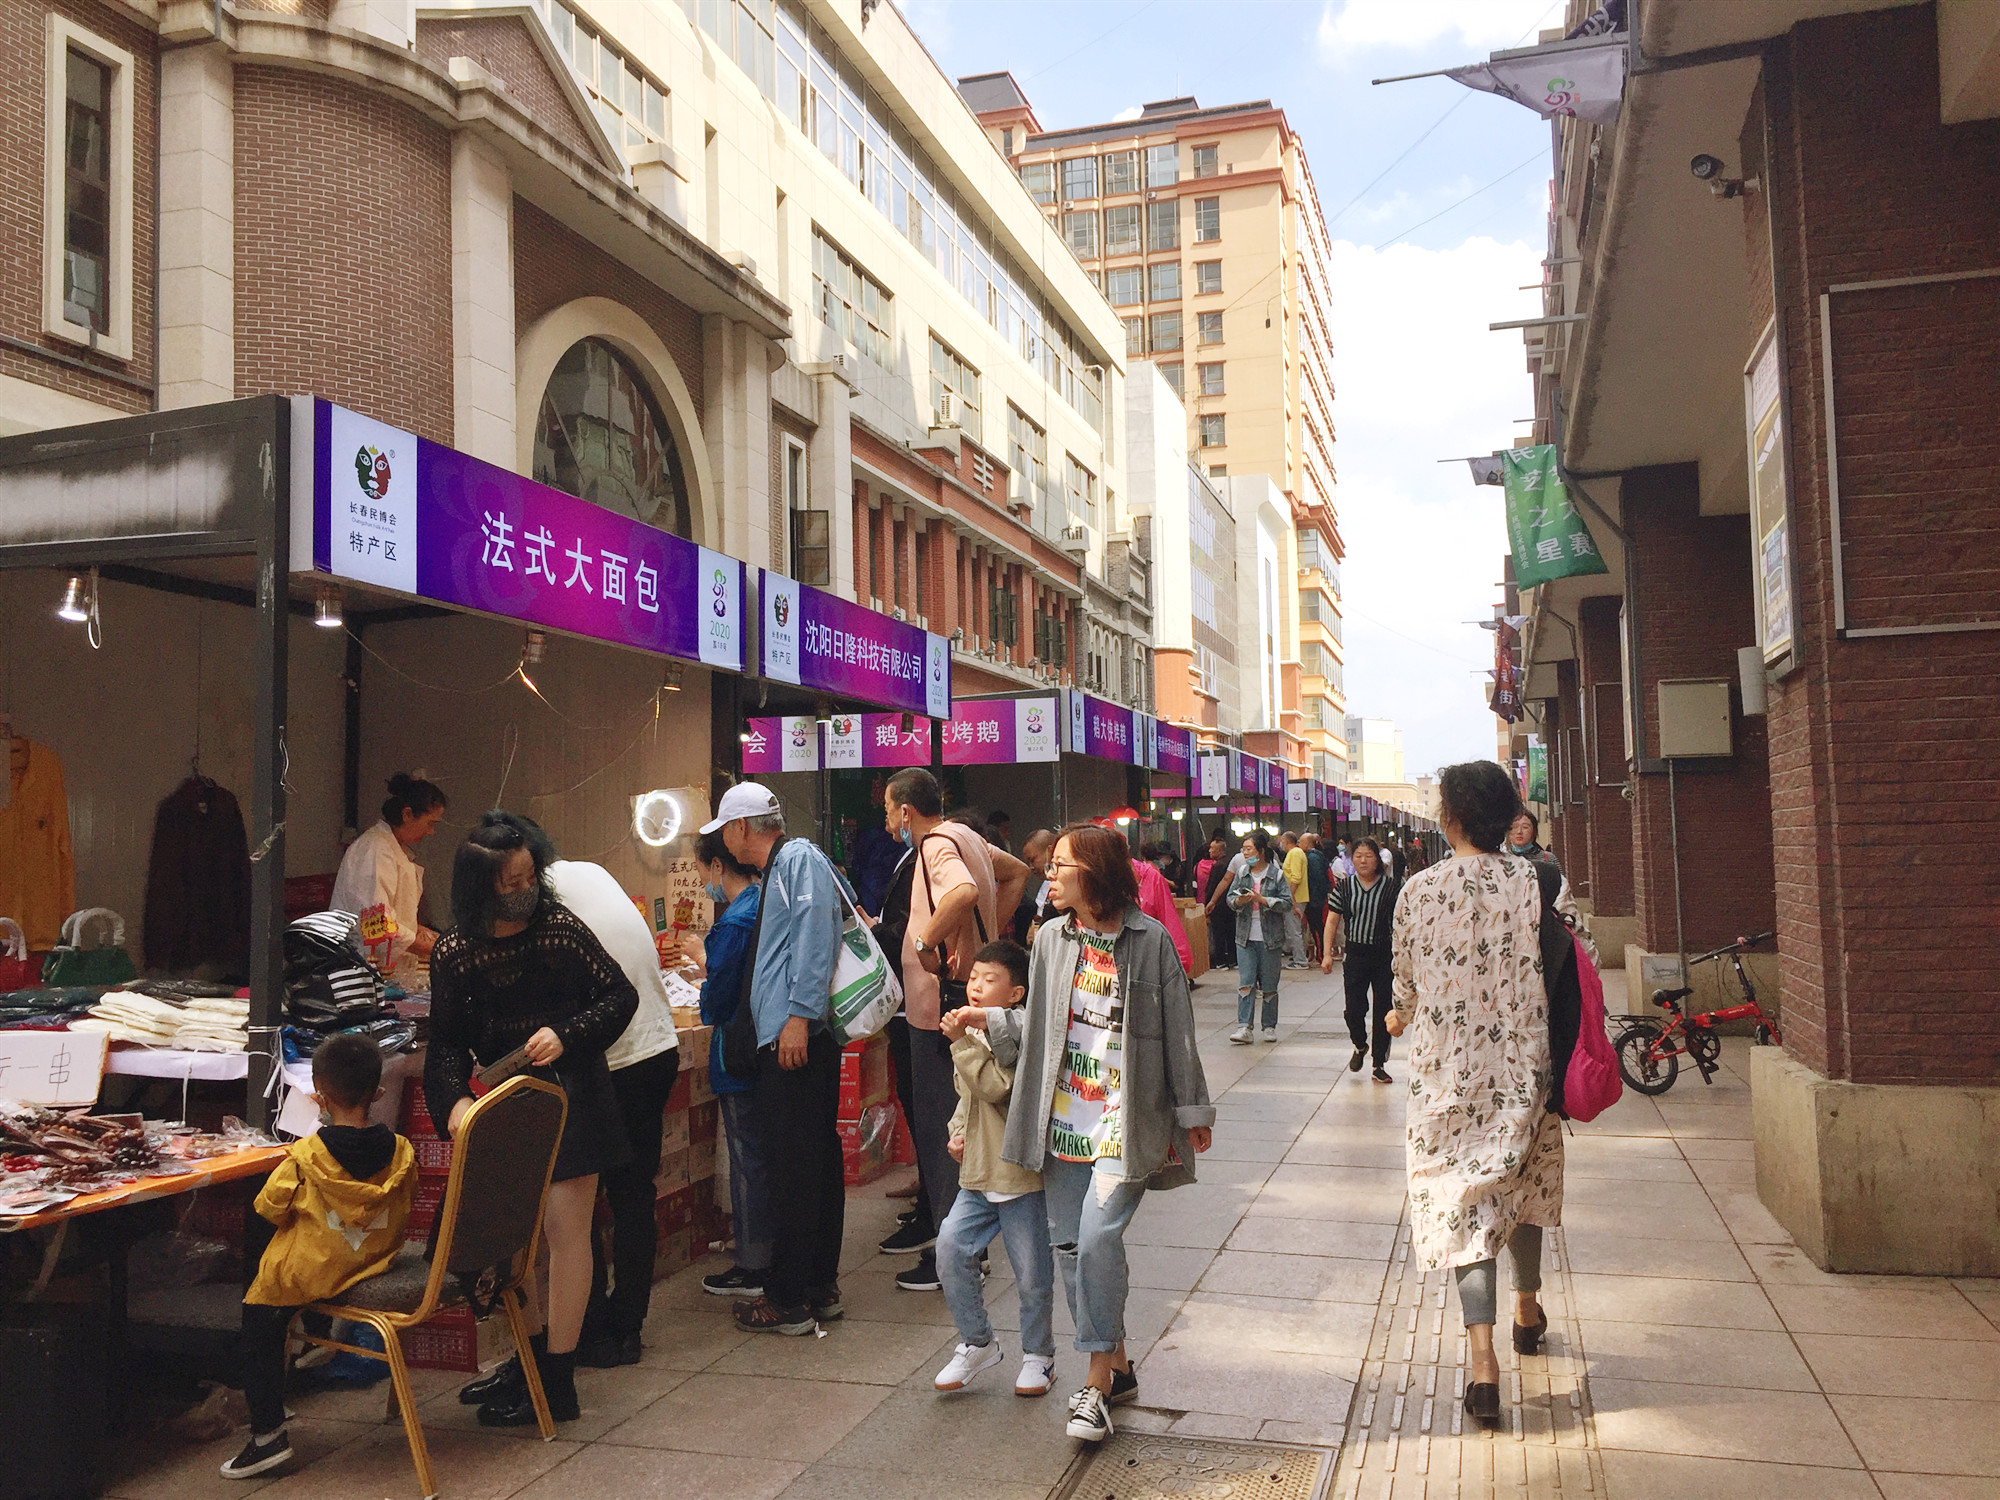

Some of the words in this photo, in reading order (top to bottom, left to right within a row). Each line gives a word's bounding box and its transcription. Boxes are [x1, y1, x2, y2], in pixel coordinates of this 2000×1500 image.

[350, 501, 397, 526] 长春民博会
[1543, 444, 1596, 558] 艺大赛
[349, 530, 397, 561] 特产区
[480, 510, 660, 614] 法式大面包
[710, 620, 731, 640] 2020
[772, 648, 791, 665] 特产区
[805, 619, 922, 685] 沈阳日隆科技有限公司
[931, 684, 944, 698] 2020
[788, 749, 812, 758] 2020
[1023, 736, 1048, 746] 2020
[1053, 1129, 1093, 1157] MARKET
